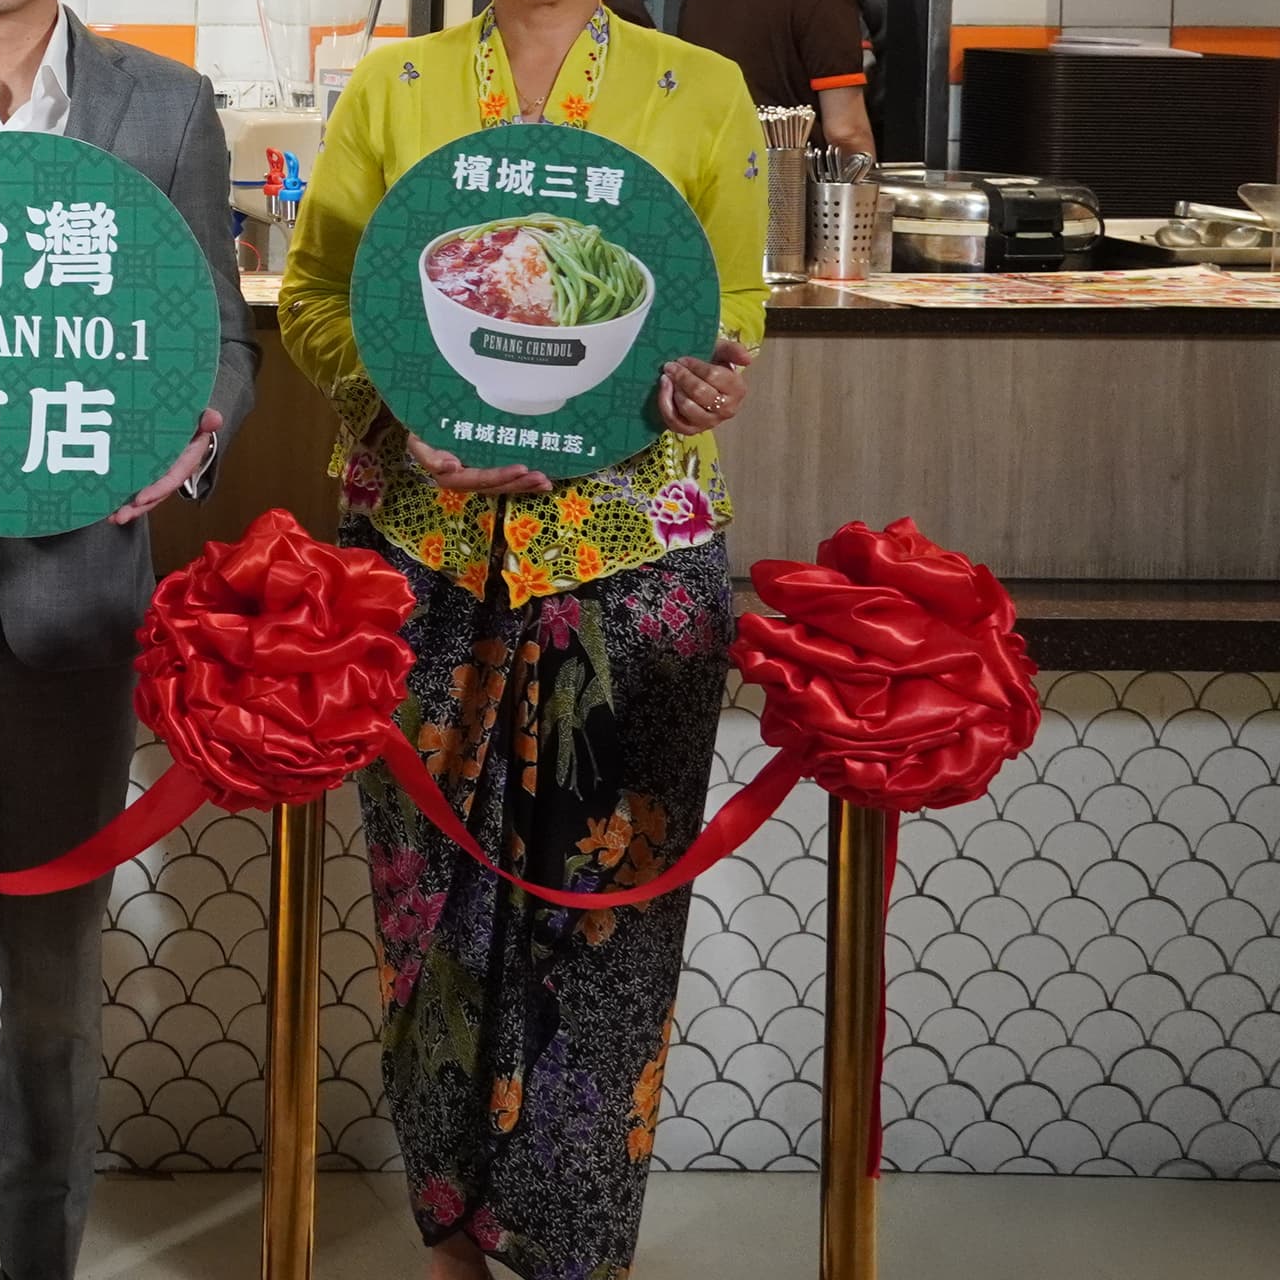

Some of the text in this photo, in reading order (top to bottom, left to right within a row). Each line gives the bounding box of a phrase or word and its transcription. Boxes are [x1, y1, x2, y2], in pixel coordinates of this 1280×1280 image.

[452, 153, 625, 206] 檳城三寶
[54, 316, 149, 361] NO.1
[482, 333, 573, 358] PENANG CHENDUL
